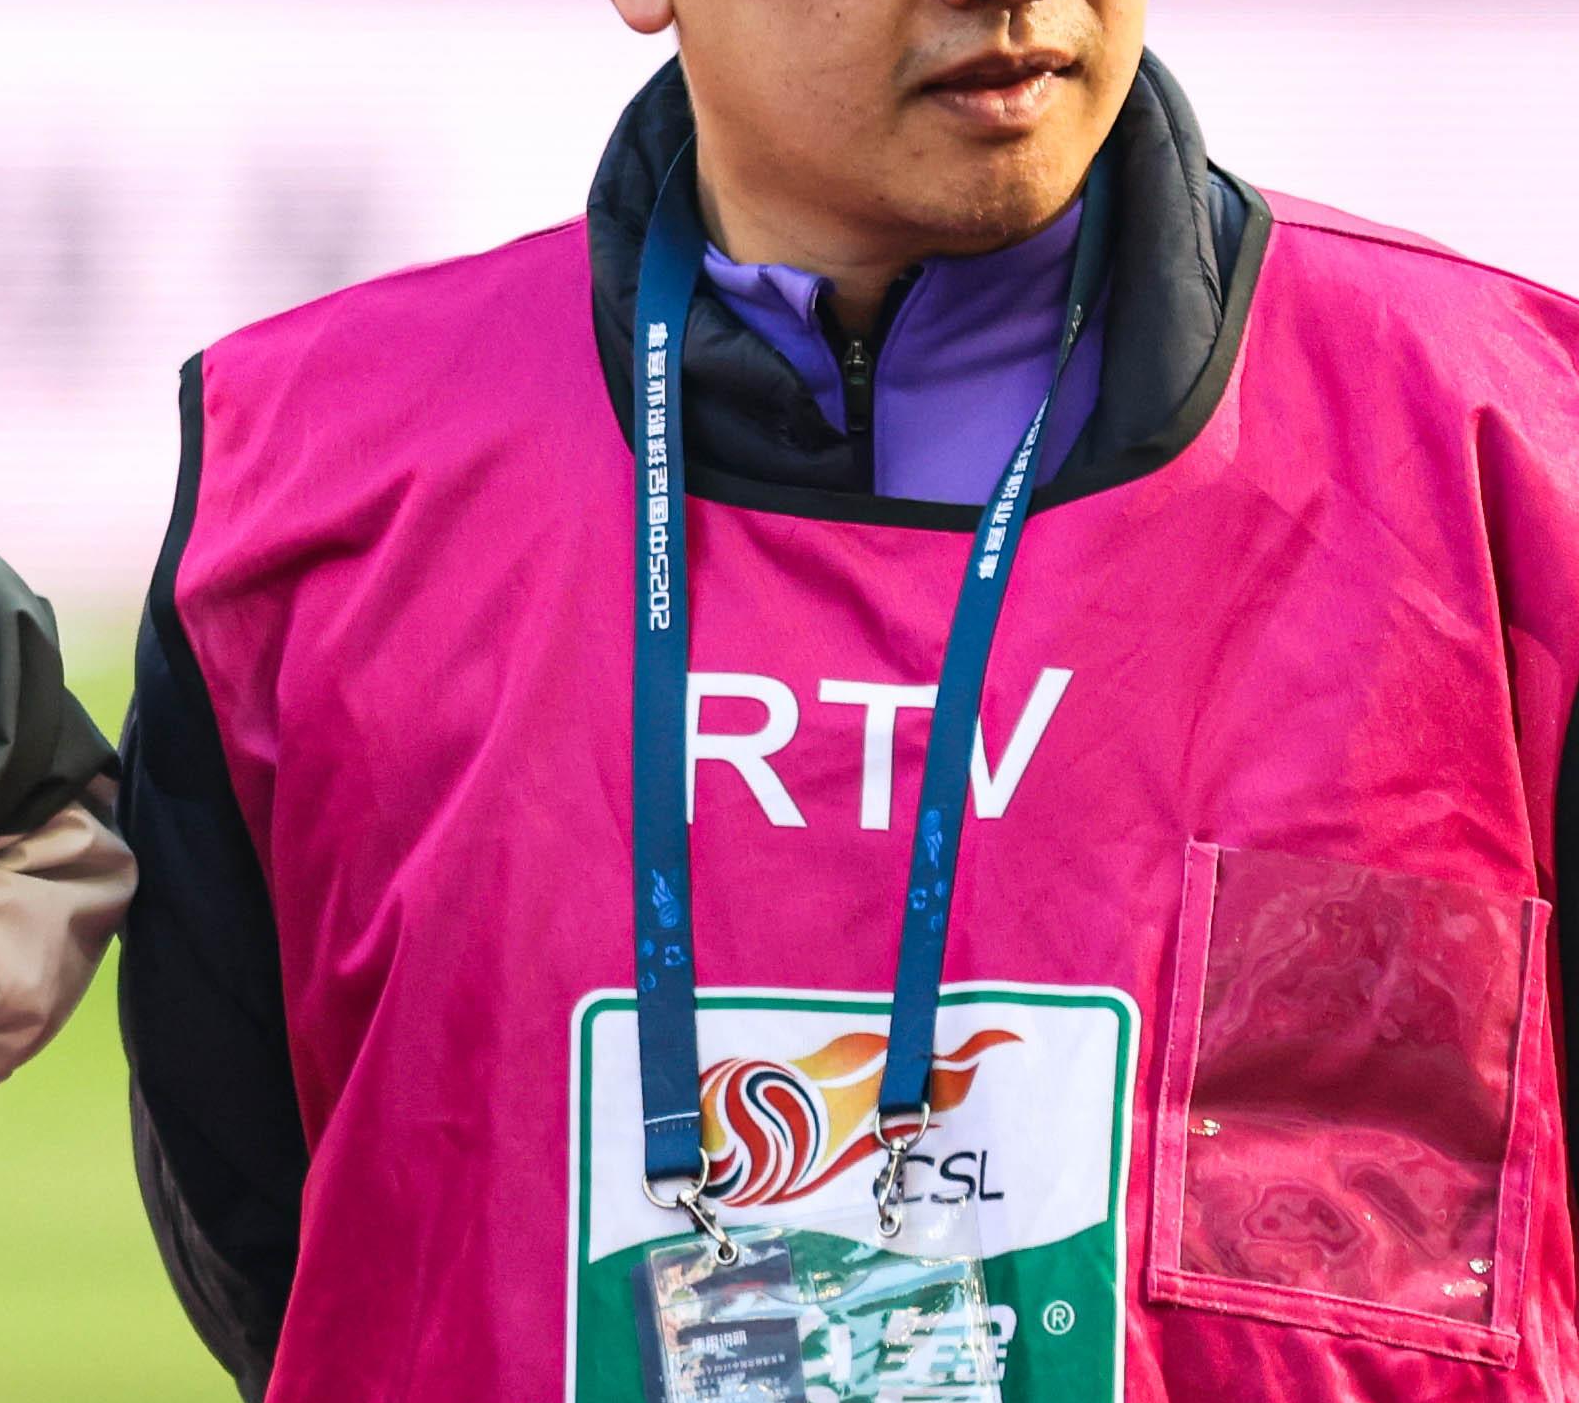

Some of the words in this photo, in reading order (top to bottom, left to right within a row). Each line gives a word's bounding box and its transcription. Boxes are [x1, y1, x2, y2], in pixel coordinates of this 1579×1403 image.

[646, 321, 671, 631] 2025中国足球职业赛事
[686, 667, 1074, 830] RTV
